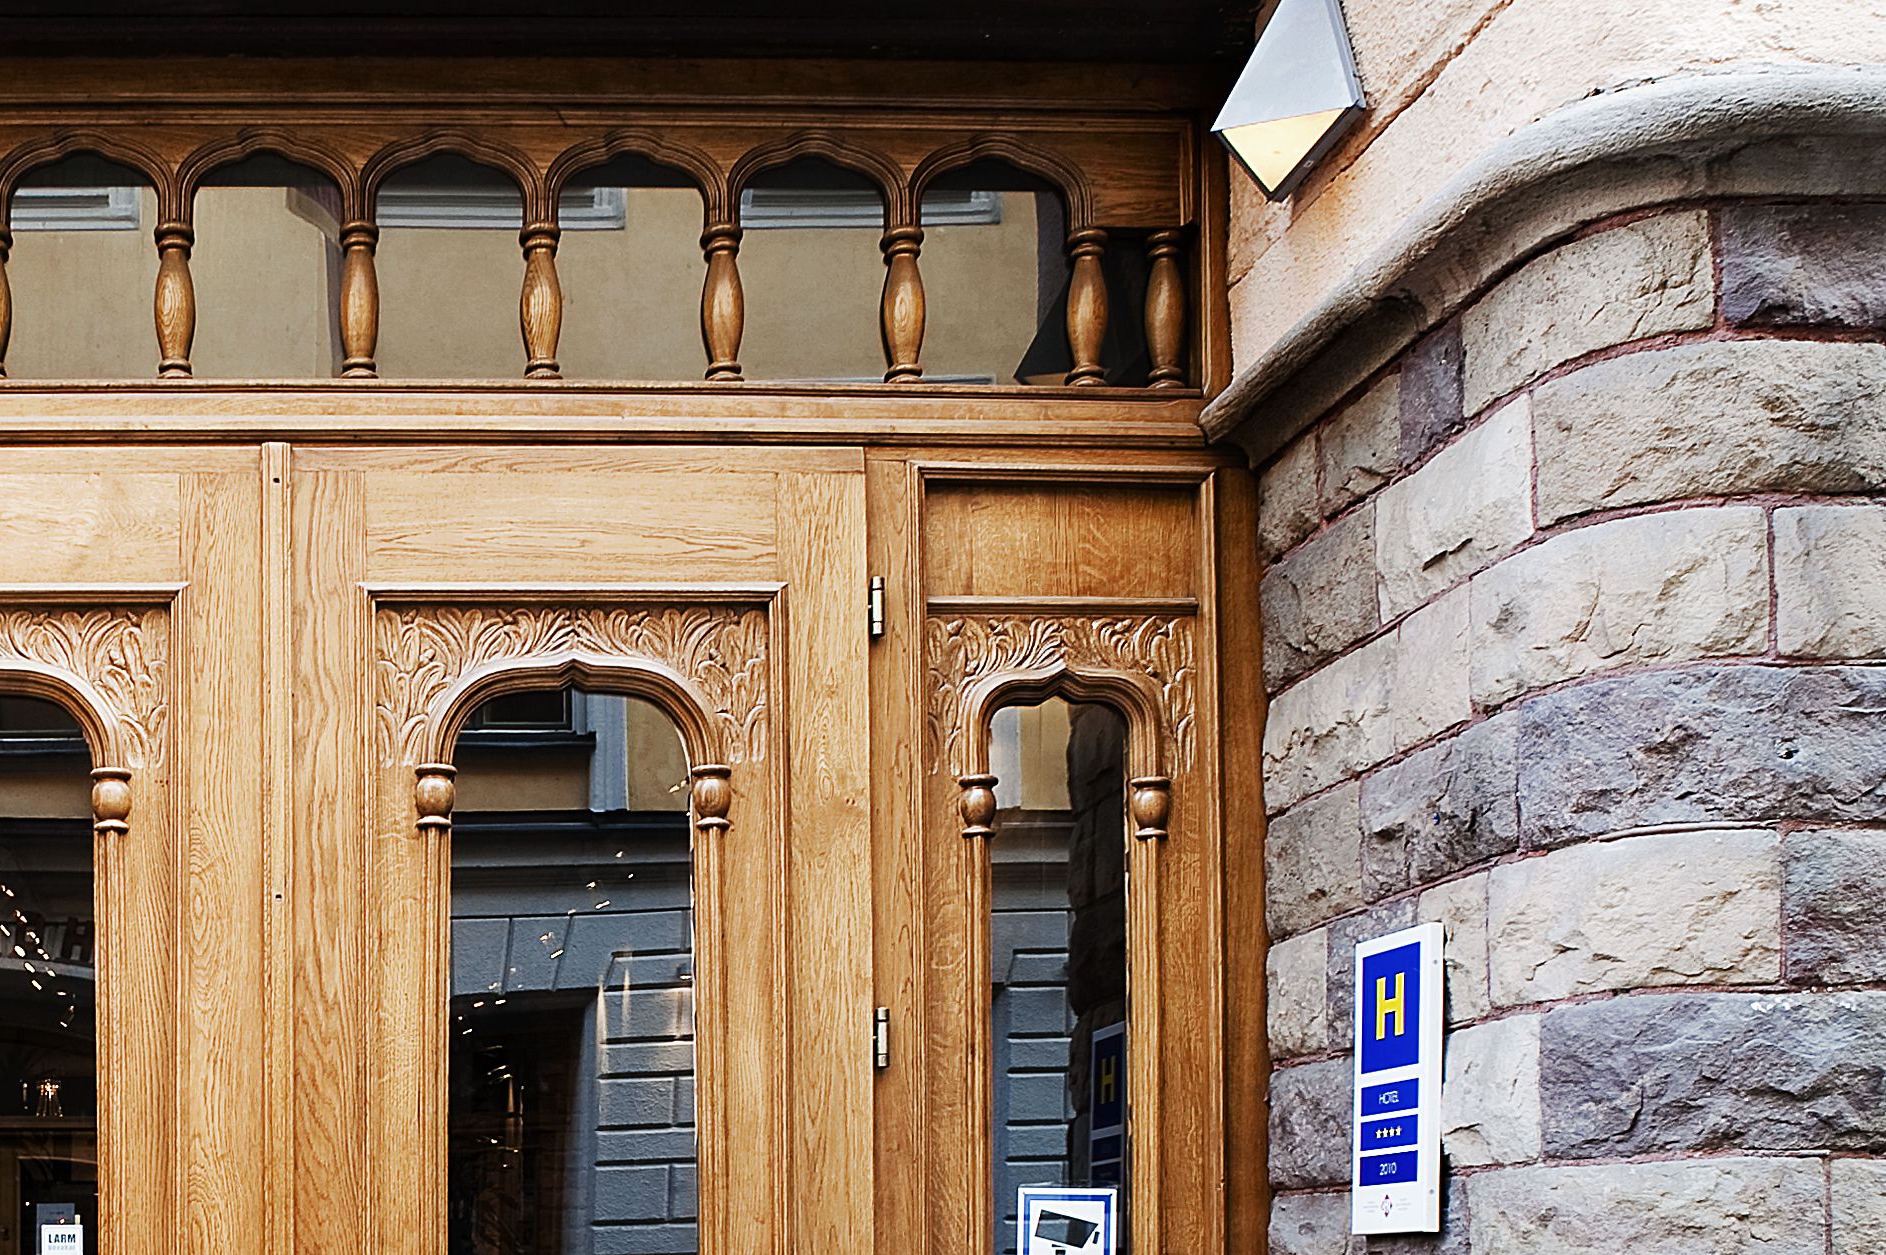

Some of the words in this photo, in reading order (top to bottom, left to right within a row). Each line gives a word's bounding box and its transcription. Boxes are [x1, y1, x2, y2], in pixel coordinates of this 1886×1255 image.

[1375, 971, 1405, 1040] H
[1378, 1090, 1400, 1105] HOTEL
[1379, 1162, 1397, 1176] 2010
[48, 1233, 76, 1244] LARM
